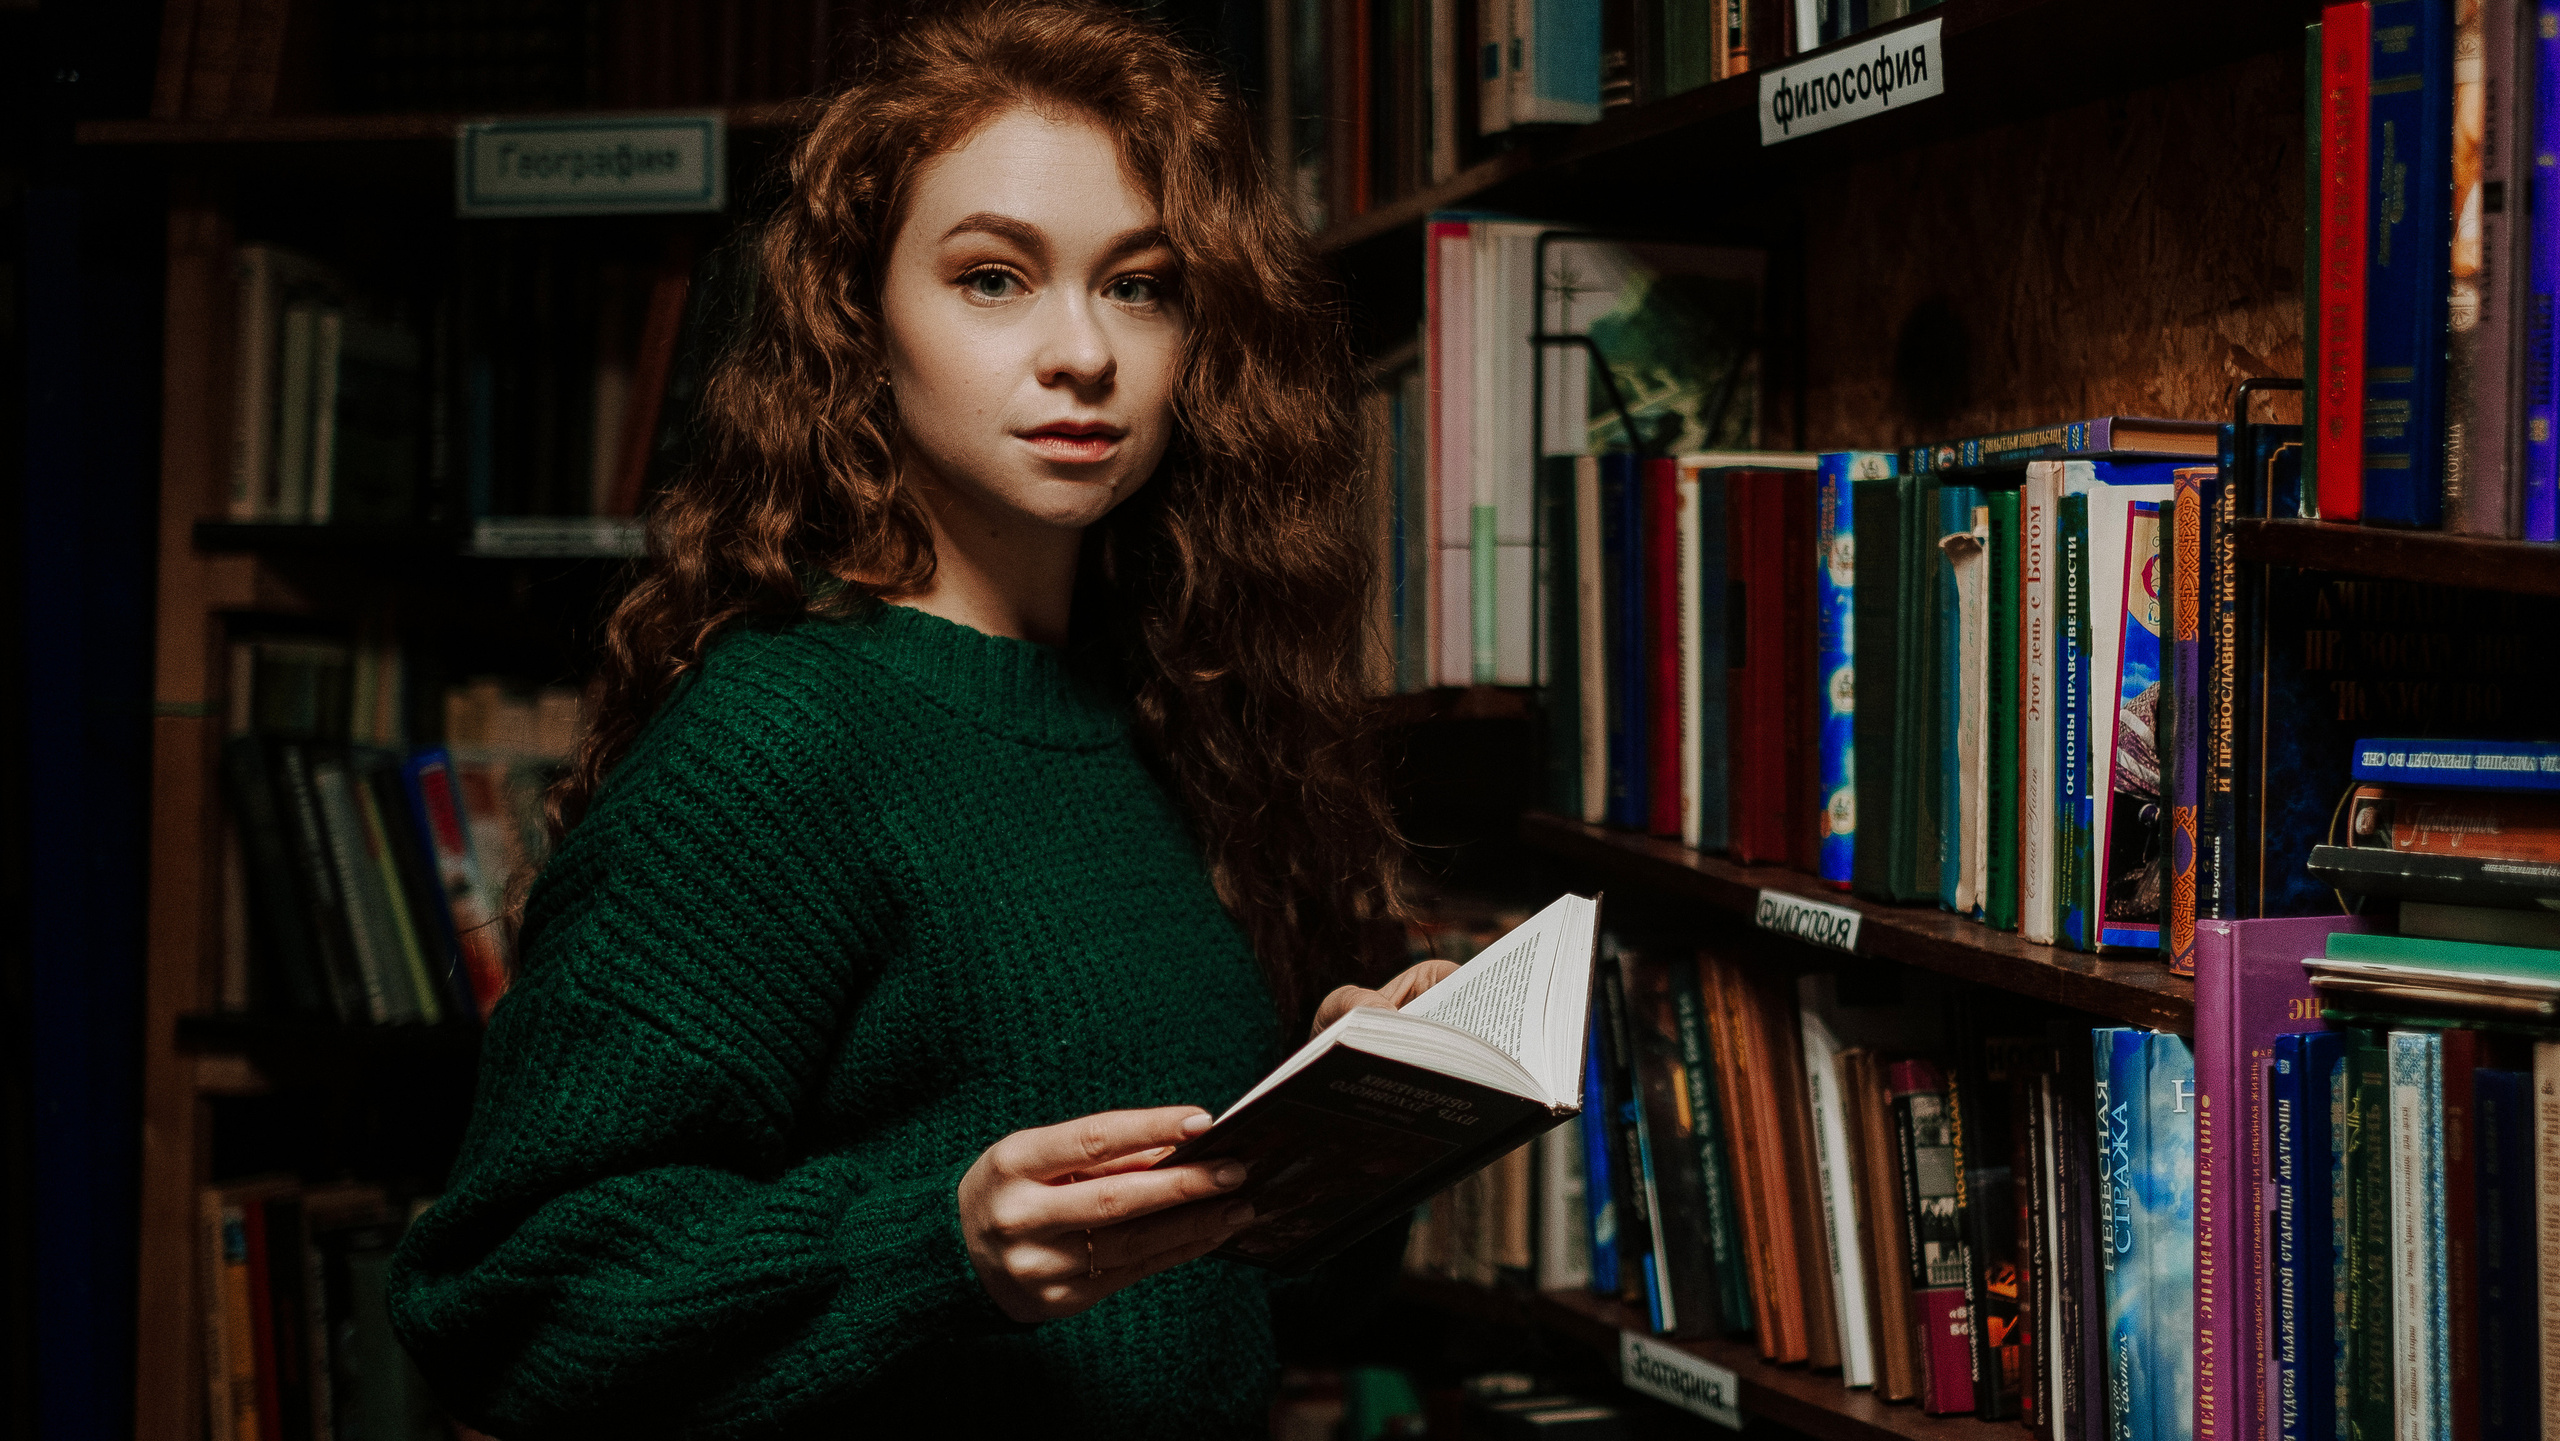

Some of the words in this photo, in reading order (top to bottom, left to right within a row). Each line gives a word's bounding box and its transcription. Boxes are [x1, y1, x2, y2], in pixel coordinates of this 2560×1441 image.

[1773, 45, 1927, 135] философия
[499, 143, 678, 184] География
[2447, 423, 2461, 483] КОРАНА
[2447, 485, 2458, 497] И
[2026, 504, 2041, 584] Богом
[2030, 596, 2041, 609] с
[2067, 534, 2078, 708] НРАВСТВЕННОСТИ
[2030, 617, 2043, 667] день
[2028, 674, 2041, 721] Этот
[2219, 612, 2235, 767] ПРАВОСЛАВНОЕ
[2066, 713, 2076, 796] ОСНОВЫ
[2219, 778, 2231, 793] И
[2361, 752, 2387, 768] СНЕ
[2387, 752, 2406, 768] ВО
[2406, 752, 2474, 770] ПРИХОДЯТ
[2474, 755, 2538, 772] УМЕРШИЕ
[1759, 898, 1851, 948] ФИЛОСОФИЯ
[1946, 1071, 1968, 1209] НОСТРАДАМУС
[2250, 1105, 2260, 1165] СЕМЕЙНАЯ
[2277, 1099, 2292, 1180] МАТРОНЫ
[2096, 1080, 2115, 1273] НЕБЕСНАЯ
[2111, 1101, 2131, 1253] СТРАЖА
[2200, 1112, 2215, 1320] ЭНЦИКЛОПЕДИЯ
[2252, 1210, 2262, 1275] ГЕОГРАФИЯ
[2279, 1184, 2294, 1262] СТАРИЦЫ
[2253, 1278, 2263, 1351] БИБЛЕЙСКАЯ
[2279, 1267, 2295, 1363] БЛАЖЕННОЙ
[2119, 1331, 2130, 1414] святых
[2281, 1368, 2298, 1428] ЧУДЕСА
